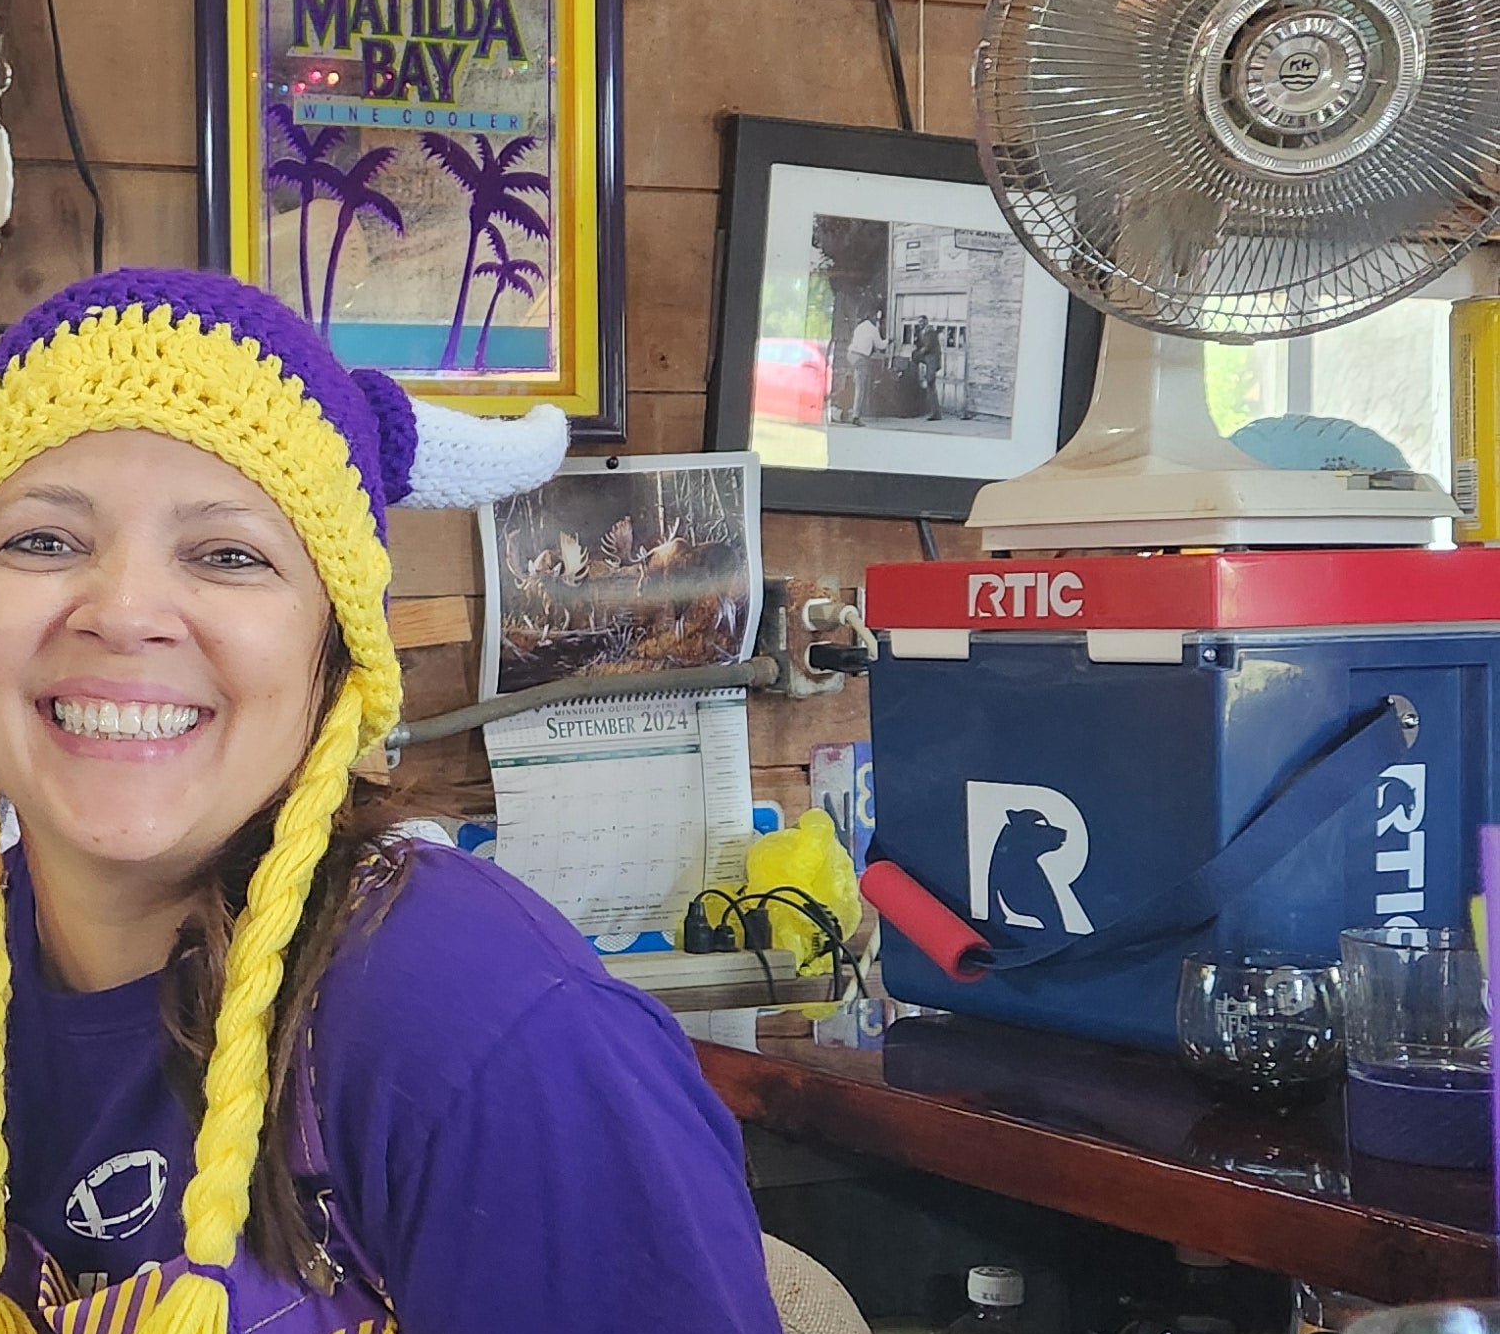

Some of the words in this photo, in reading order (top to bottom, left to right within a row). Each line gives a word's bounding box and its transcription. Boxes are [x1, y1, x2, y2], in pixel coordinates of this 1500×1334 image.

[360, 36, 469, 106] BAY
[302, 104, 382, 124] WINE
[402, 109, 521, 131] COOLER
[967, 571, 1083, 619] RTIC
[547, 716, 636, 740] SEPTEMBER
[641, 709, 688, 733] 2024
[555, 705, 605, 717] MINNESOTA
[608, 703, 651, 714] OUTDOOR
[1376, 763, 1429, 964] RTIC
[1217, 1013, 1248, 1037] NFL
